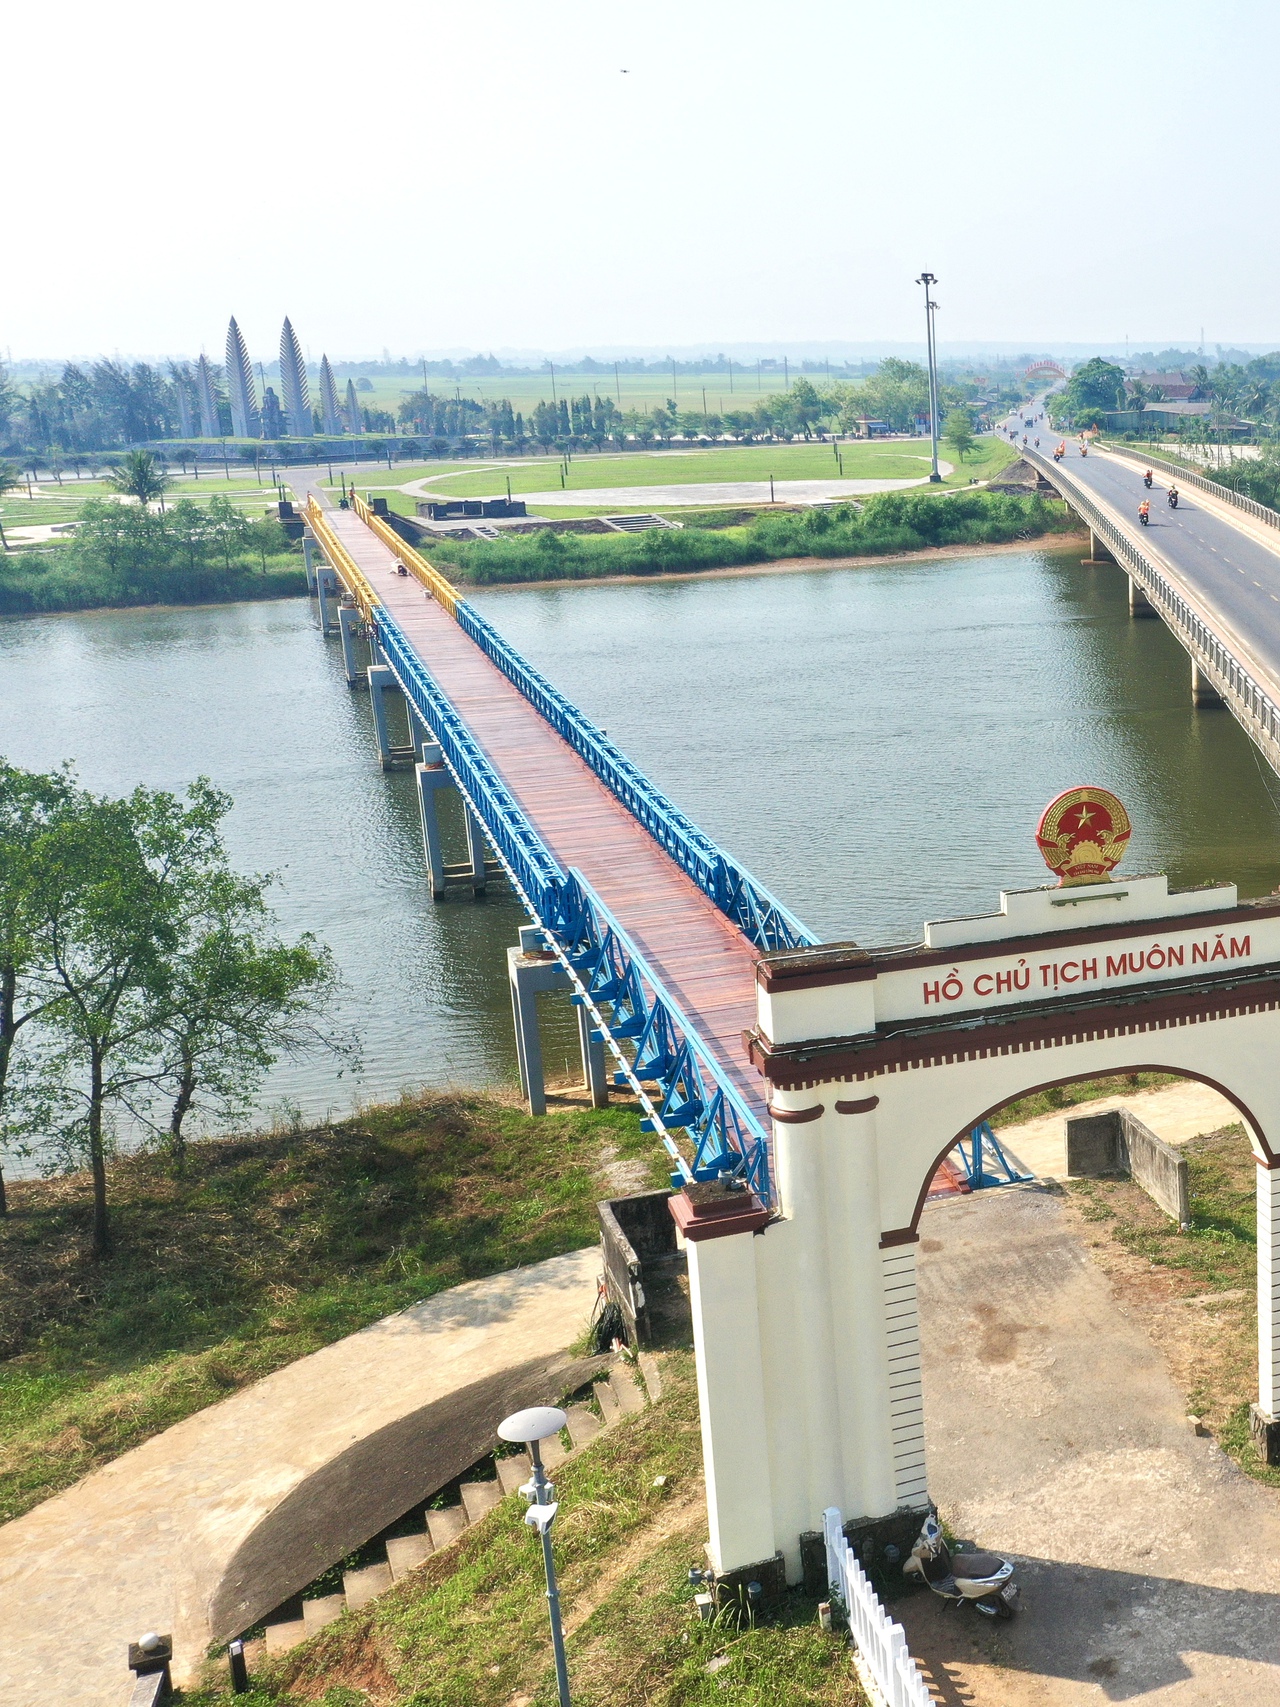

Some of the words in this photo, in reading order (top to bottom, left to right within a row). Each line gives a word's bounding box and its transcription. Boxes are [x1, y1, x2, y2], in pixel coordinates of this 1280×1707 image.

[923, 967, 963, 1004] HỒ
[973, 958, 1030, 996] CHỦ
[1039, 957, 1097, 991] TỊCH
[1106, 943, 1184, 977] MUÔN
[1192, 933, 1251, 964] NĂM
